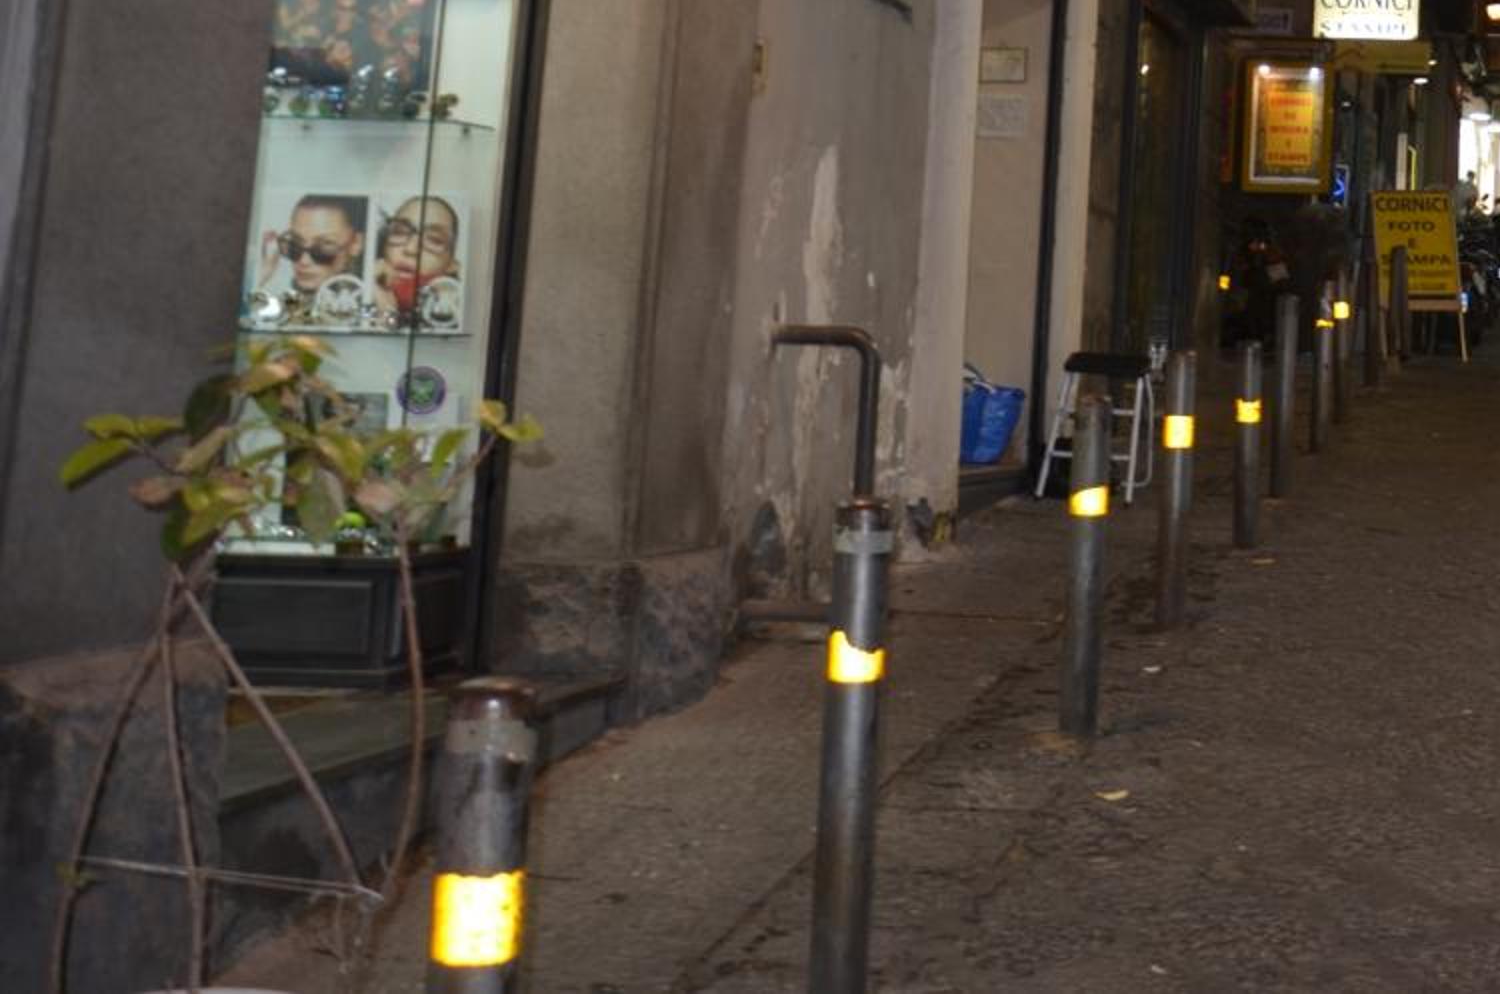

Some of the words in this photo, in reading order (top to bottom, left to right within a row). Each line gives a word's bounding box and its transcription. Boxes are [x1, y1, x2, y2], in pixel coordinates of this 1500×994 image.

[1375, 196, 1449, 213] CORNICI
[1387, 220, 1436, 233] FOTO
[1380, 253, 1452, 266] SAMPA
